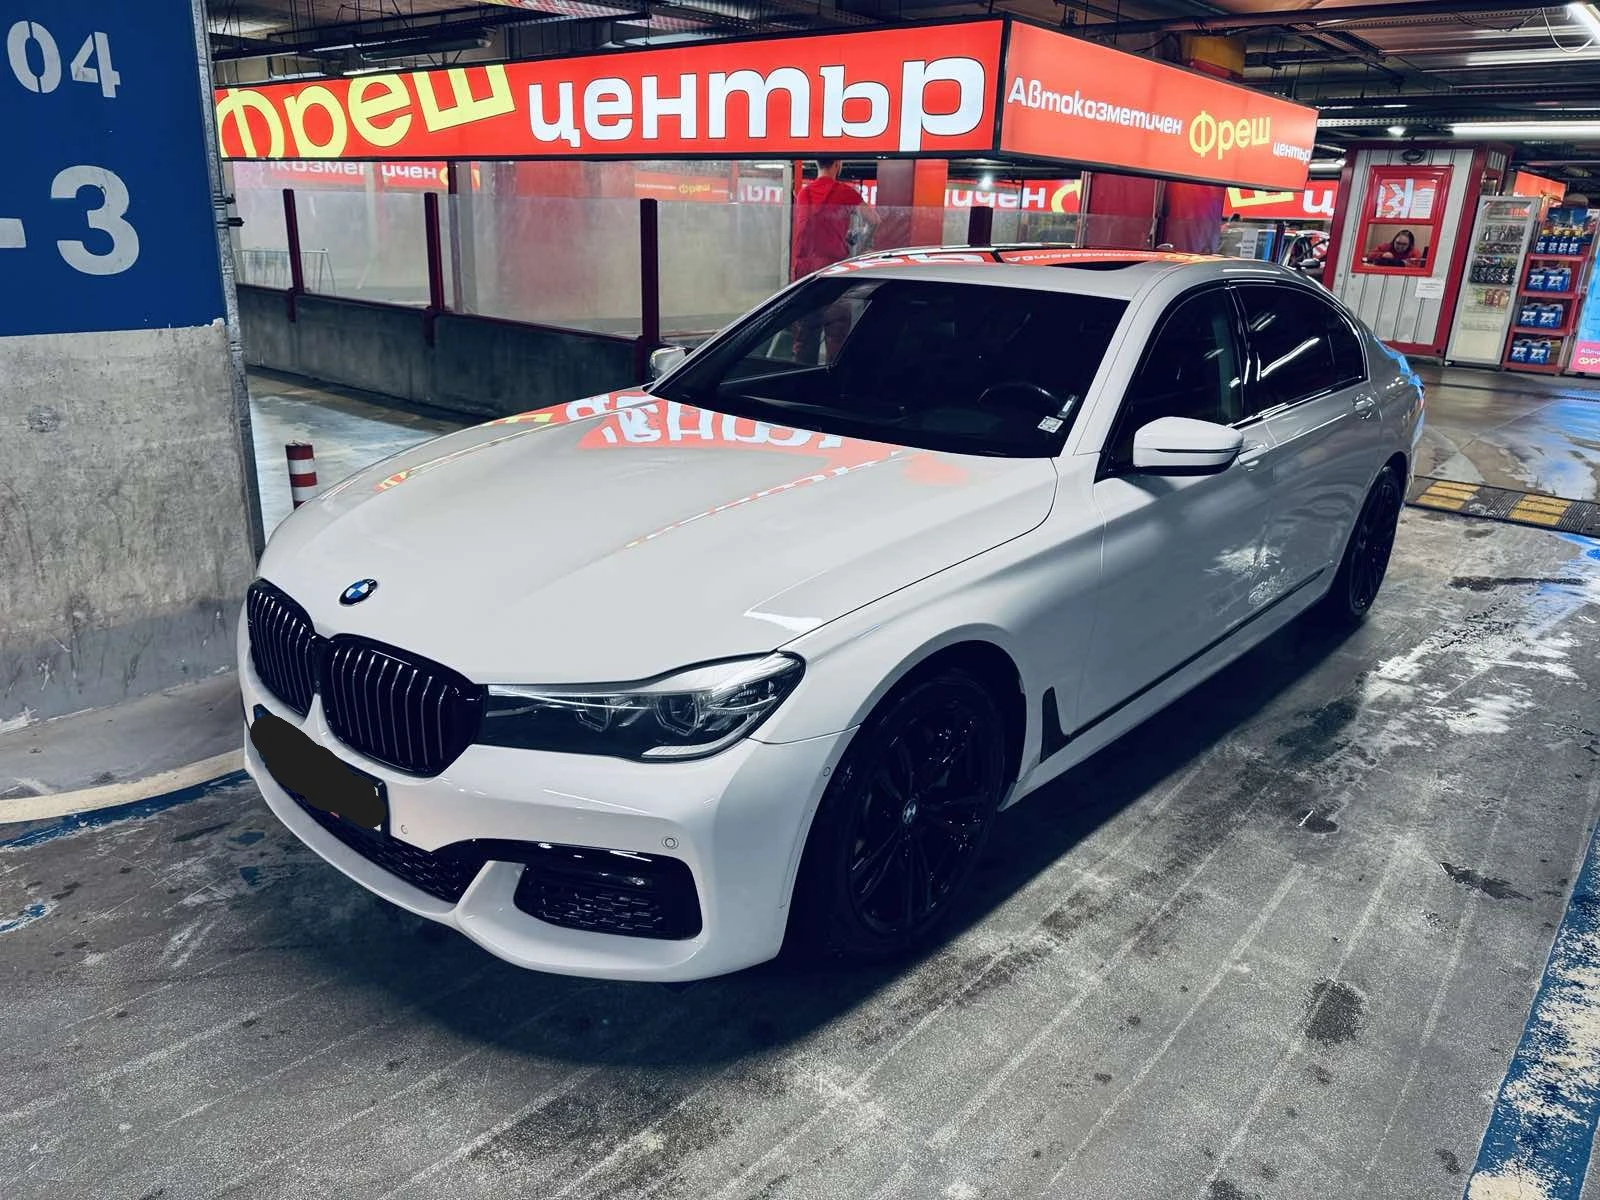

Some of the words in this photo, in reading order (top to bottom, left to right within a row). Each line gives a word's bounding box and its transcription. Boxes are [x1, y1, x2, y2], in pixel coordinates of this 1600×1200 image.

[7, 20, 121, 98] 04
[215, 64, 517, 159] Фреш
[528, 57, 986, 152] център
[1007, 77, 1183, 136] Автокозметичен
[1188, 110, 1272, 161] Фреш
